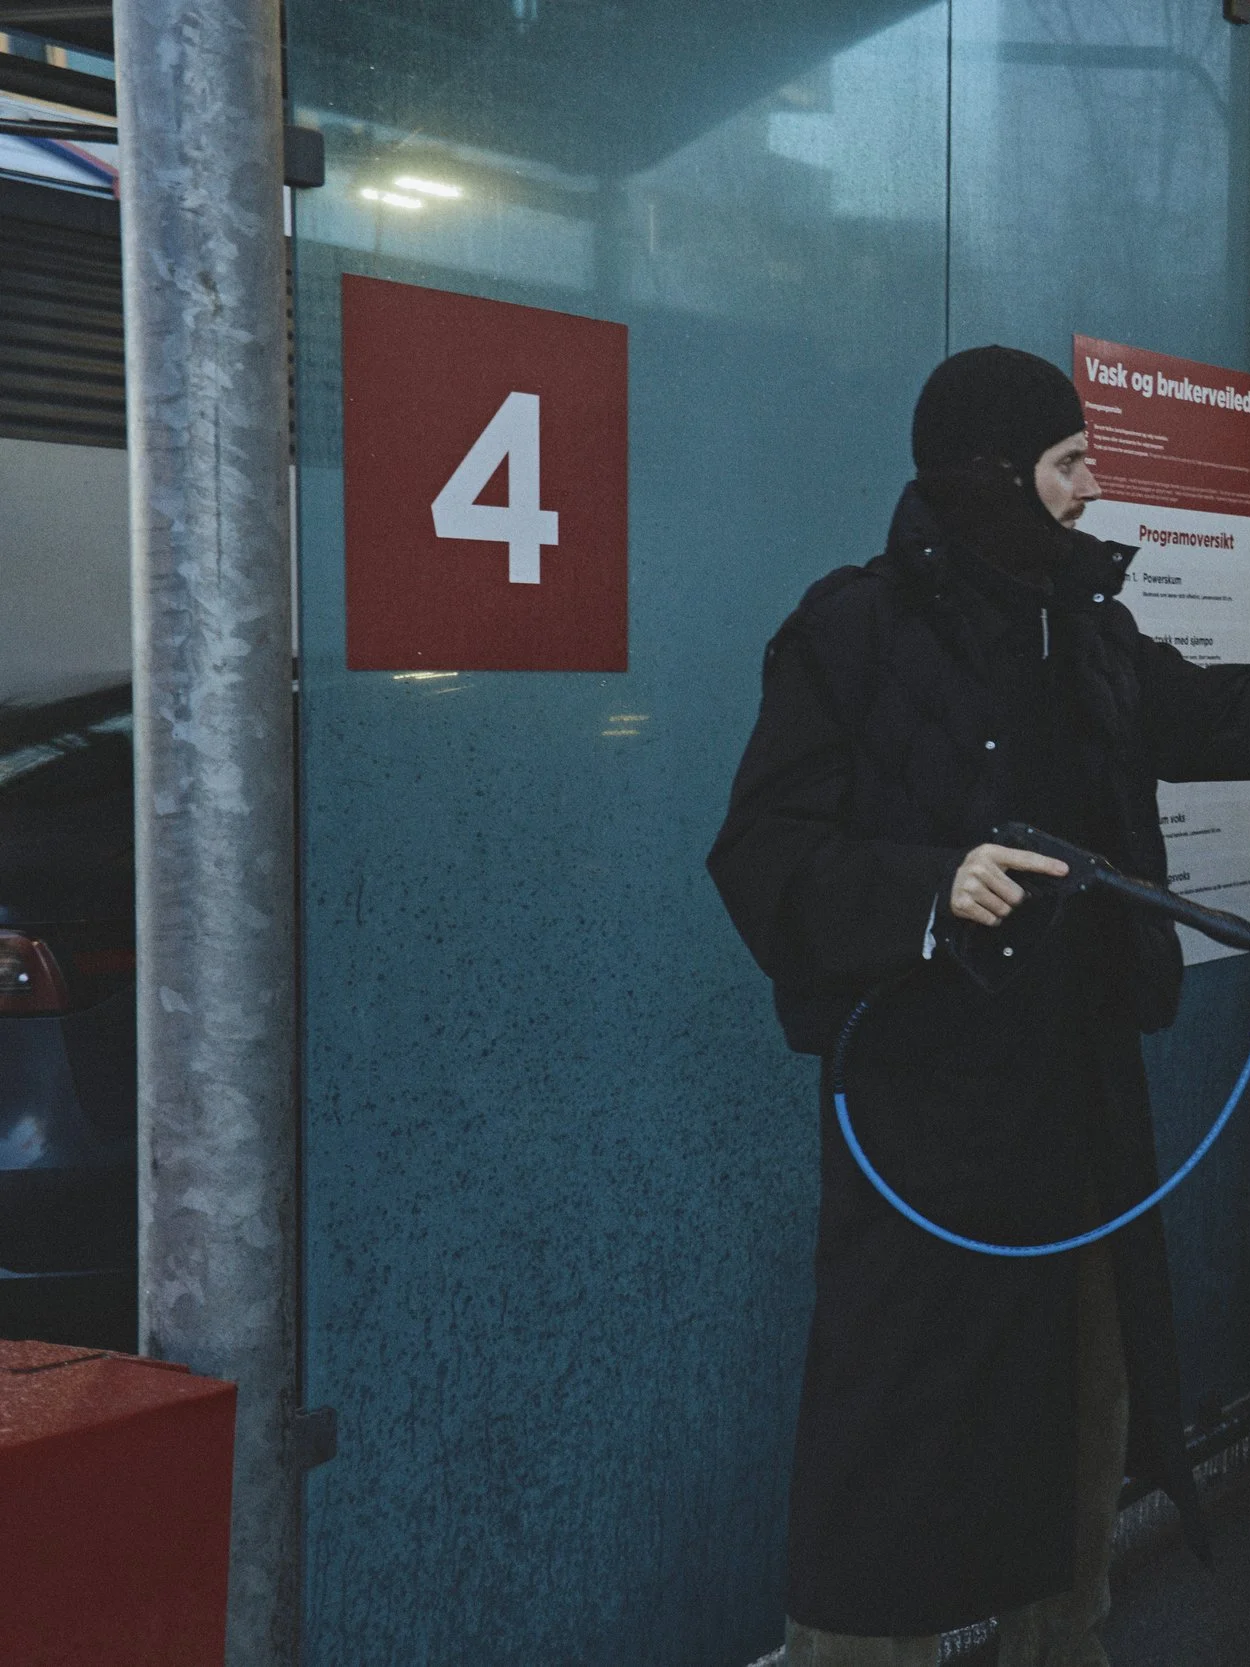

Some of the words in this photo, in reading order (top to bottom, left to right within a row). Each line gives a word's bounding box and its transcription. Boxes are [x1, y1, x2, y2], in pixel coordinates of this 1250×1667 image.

[1085, 356, 1128, 389] Vask
[1131, 372, 1153, 398] og
[431, 391, 559, 585] 4
[1139, 524, 1234, 550] Programoversikt
[1143, 572, 1182, 585] Powerskum
[1174, 636, 1188, 646] med
